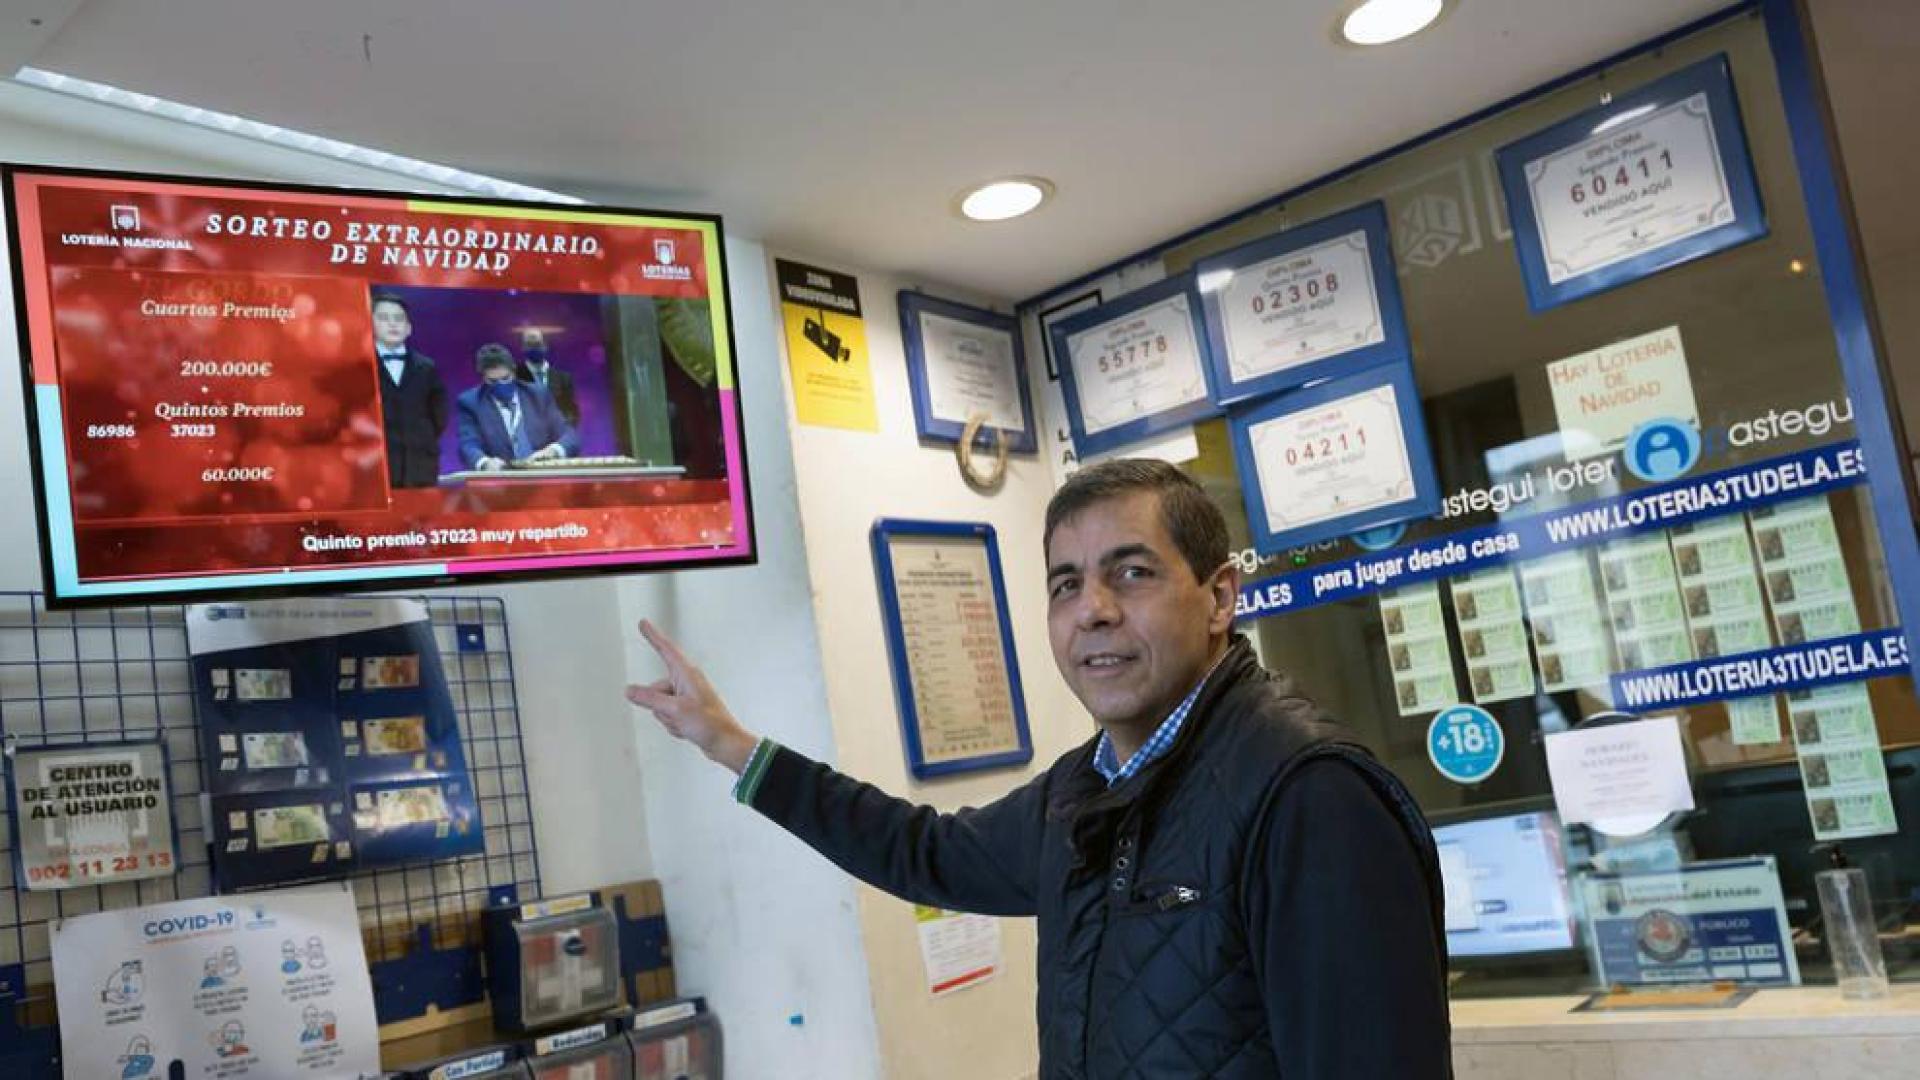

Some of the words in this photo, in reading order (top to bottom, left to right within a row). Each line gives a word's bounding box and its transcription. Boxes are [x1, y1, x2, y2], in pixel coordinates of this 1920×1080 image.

[1570, 148, 1673, 204] 60411
[123, 235, 192, 251] NACIONAL
[206, 214, 332, 239] SORTEO
[345, 222, 600, 255] EXTRAORDINARIO
[330, 244, 368, 264] DE
[382, 247, 511, 271] NAVIDAD
[1252, 272, 1338, 314] 02308
[141, 299, 218, 318] Cuartos
[222, 301, 297, 320] Premios
[1098, 335, 1168, 373] 55778
[180, 361, 273, 378] 200.000€
[1605, 371, 1624, 389] DE
[1580, 380, 1661, 413] NAVIDAD
[155, 402, 228, 420] Quintos
[232, 402, 305, 417] Premios
[87, 425, 136, 438] 86986
[171, 424, 216, 438] 37023
[1285, 425, 1367, 466] 04211
[202, 467, 275, 483] 60.000€
[303, 535, 362, 552] Quinto
[367, 530, 426, 551] premio
[430, 528, 477, 544] 37023
[481, 529, 515, 545] muy
[519, 524, 589, 542] repartido
[1312, 568, 1353, 598] para
[1355, 555, 1404, 589] jugar
[1407, 542, 1467, 572] desde
[1471, 531, 1520, 558] casa
[50, 764, 133, 782] CENTRO
[23, 788, 53, 801] DE
[57, 776, 160, 800] ATENCIÓN
[31, 804, 59, 820] AL
[65, 796, 157, 816] USUARIO
[79, 860, 103, 876] 11
[112, 855, 139, 871] 23
[147, 852, 170, 868] 13
[144, 911, 234, 936] COVID-19
